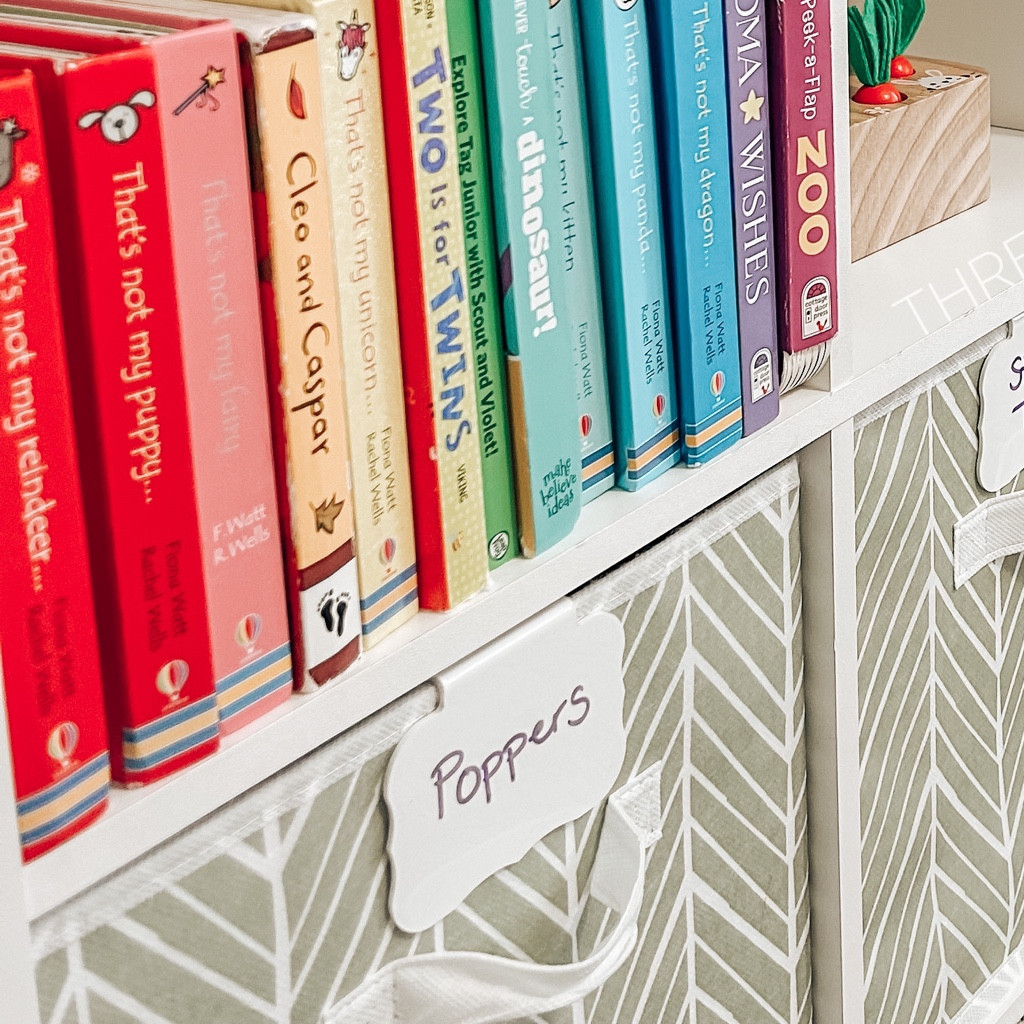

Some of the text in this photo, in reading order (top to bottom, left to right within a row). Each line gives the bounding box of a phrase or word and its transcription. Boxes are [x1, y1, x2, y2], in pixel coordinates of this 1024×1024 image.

[693, 2, 711, 73] That's
[515, 39, 538, 110] touch
[695, 79, 713, 121] not
[413, 46, 447, 174] TWO
[628, 93, 645, 136] not
[629, 141, 645, 181] my
[694, 126, 711, 164] my
[112, 161, 149, 259] That's
[350, 182, 370, 231] not
[740, 131, 769, 305] WISHES
[796, 128, 830, 256] ZOO
[0, 198, 28, 302] That's
[350, 238, 371, 283] my
[433, 220, 451, 266] for
[451, 54, 498, 459] Explore Tag Junior with Scout and Violet!
[516, 130, 558, 339] dinosaur!
[121, 267, 155, 324] not
[208, 272, 236, 326] not
[286, 151, 331, 456] Cleo and Caspar
[714, 281, 726, 357] Fiona Watt
[804, 295, 828, 308] cottage
[813, 310, 829, 320] press
[814, 303, 829, 313] door
[3, 310, 38, 372] not
[641, 303, 653, 386] Rachel Wells
[651, 299, 665, 375] Fiona Watt
[703, 284, 714, 367] Rachel Wells
[120, 330, 153, 384] my
[430, 266, 473, 452] TWINS
[3, 376, 37, 433] my
[385, 470, 397, 513] Watt
[456, 462, 469, 504] VIKING
[540, 474, 578, 507] believe
[546, 489, 575, 519] ideas
[430, 684, 591, 820] Poppers
